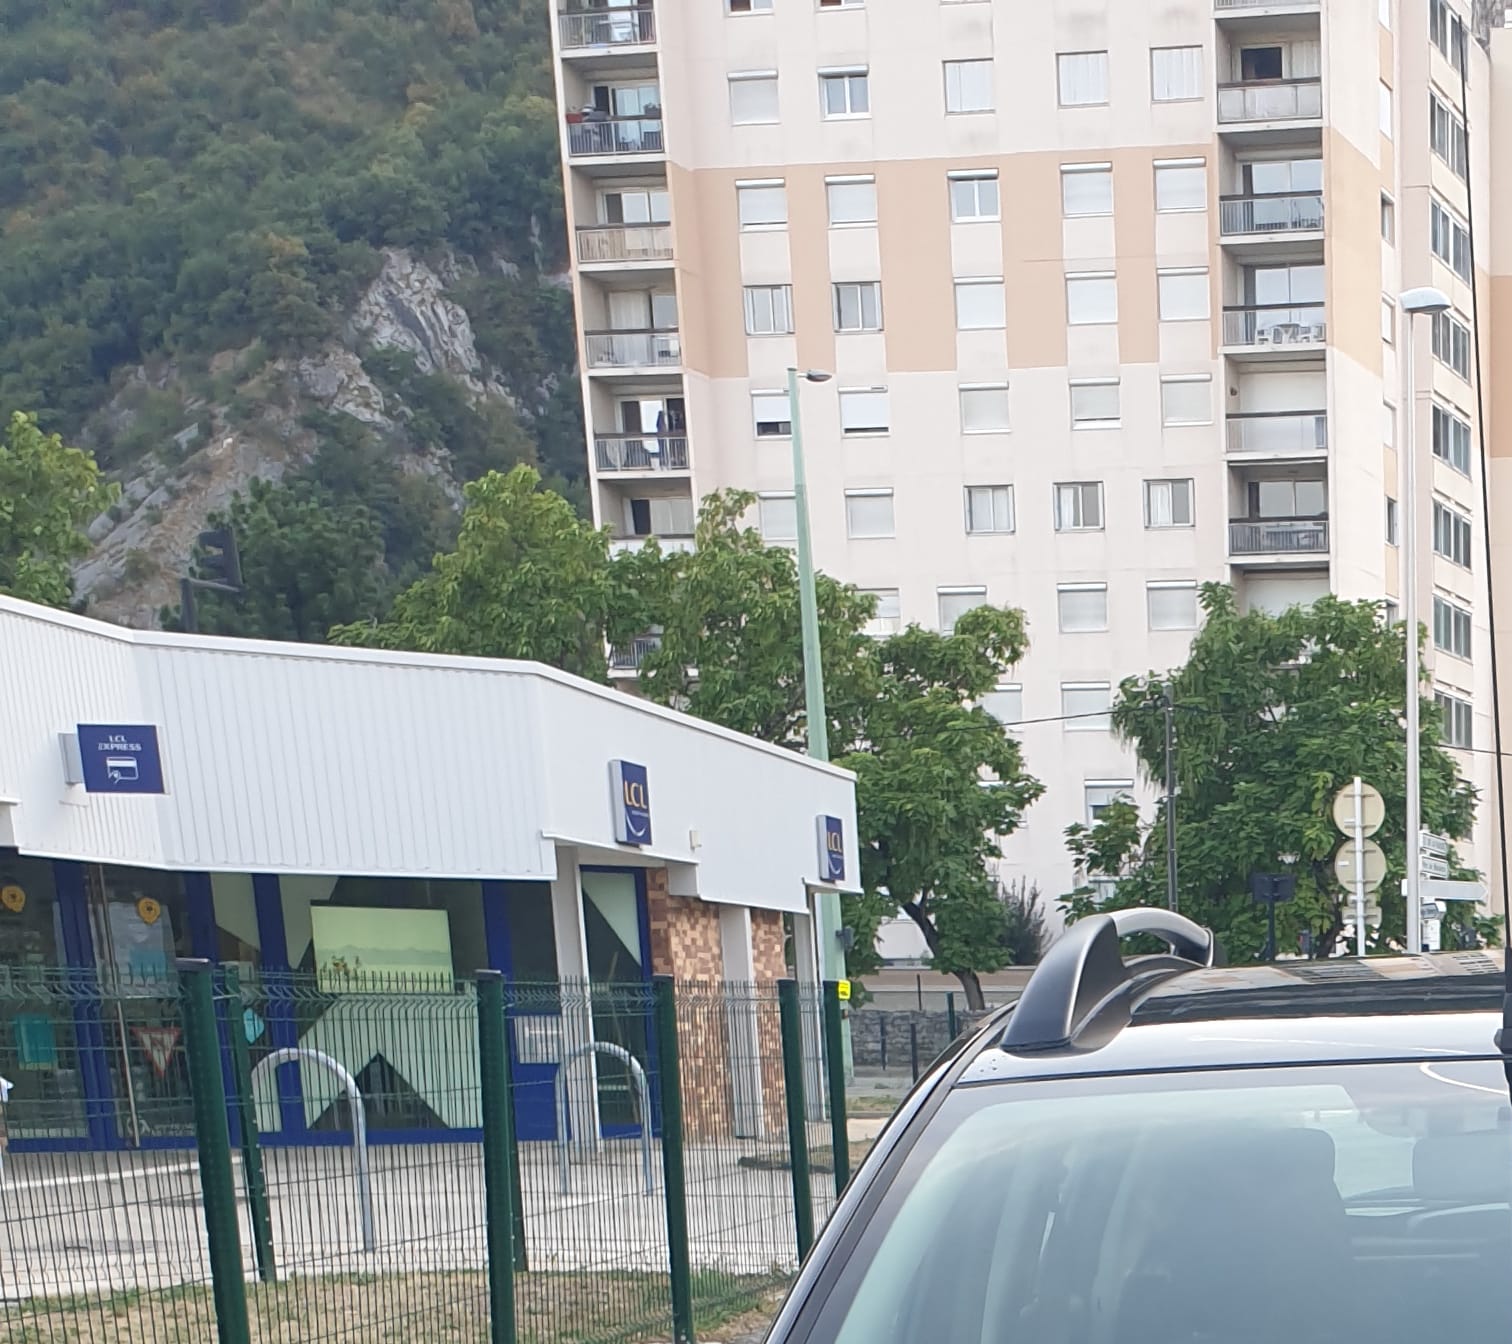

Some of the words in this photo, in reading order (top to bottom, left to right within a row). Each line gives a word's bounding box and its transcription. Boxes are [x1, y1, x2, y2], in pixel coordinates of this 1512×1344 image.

[108, 735, 127, 743] LCL
[98, 742, 142, 752] EXPRESS
[624, 780, 648, 809] LCL
